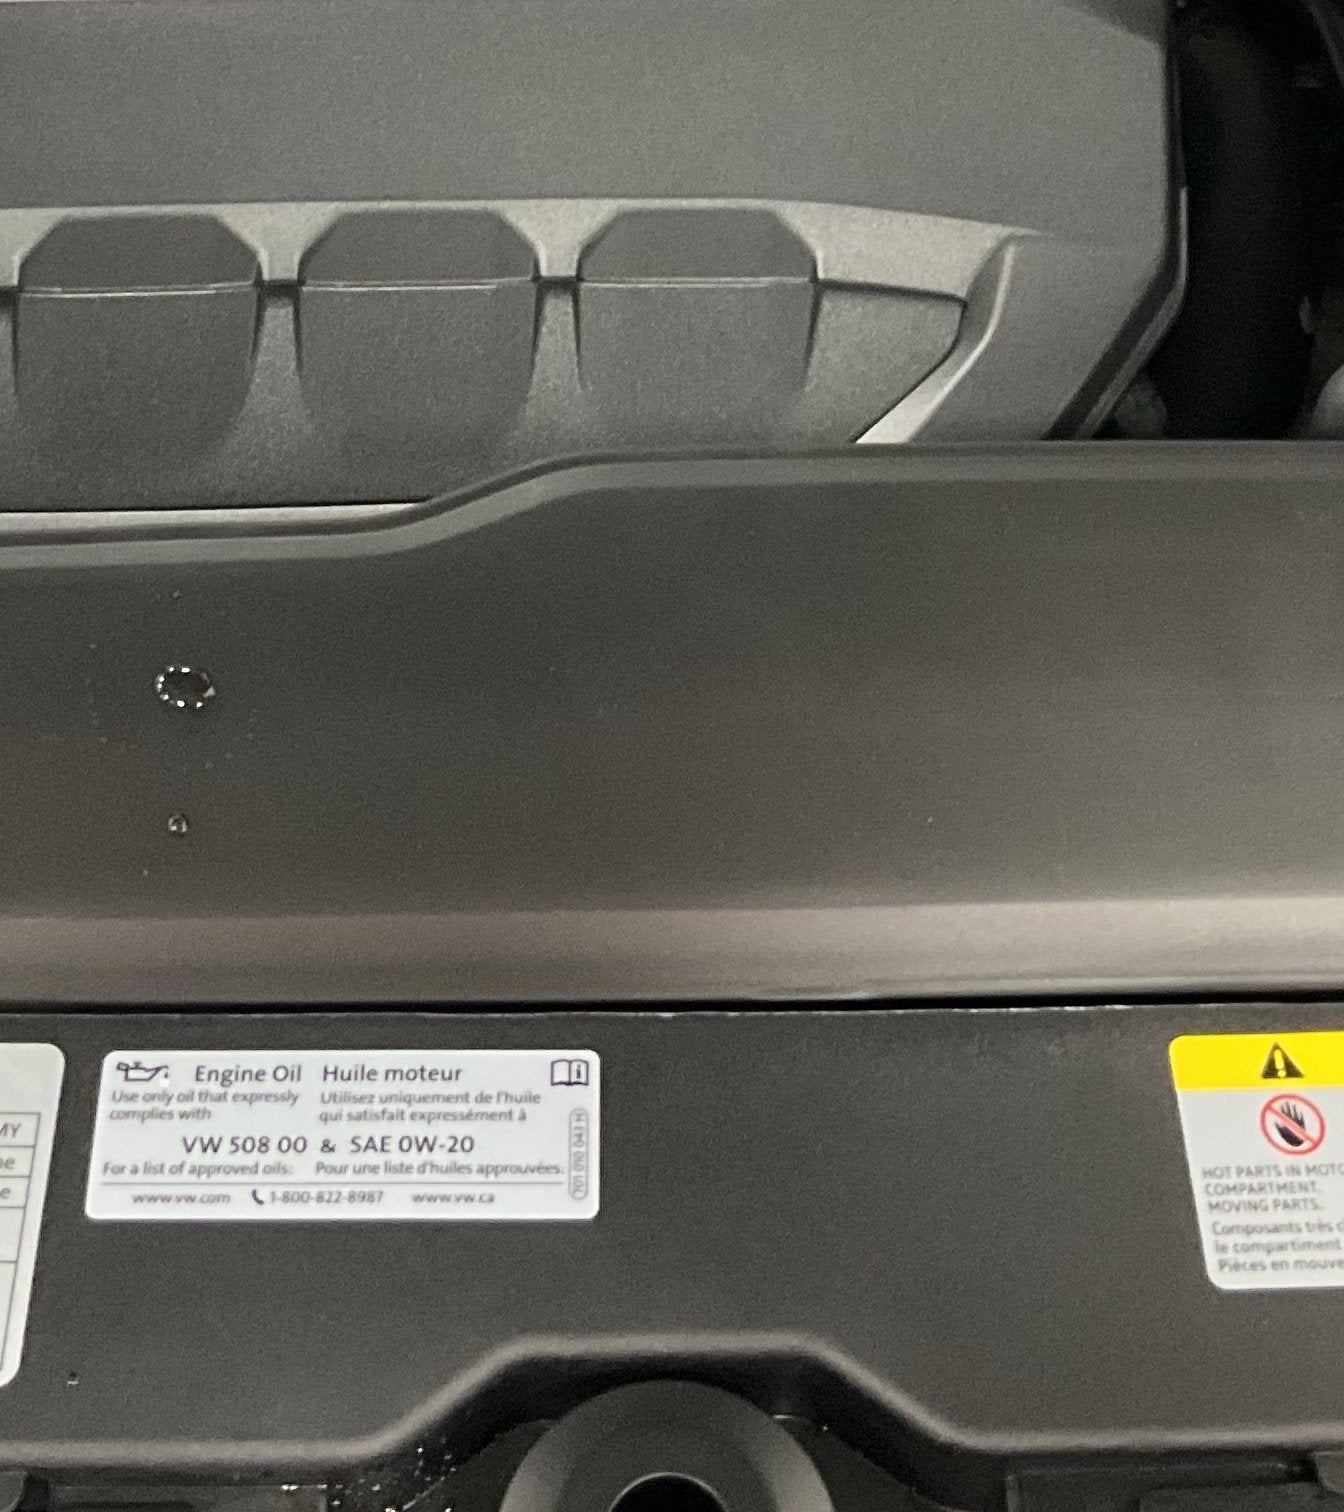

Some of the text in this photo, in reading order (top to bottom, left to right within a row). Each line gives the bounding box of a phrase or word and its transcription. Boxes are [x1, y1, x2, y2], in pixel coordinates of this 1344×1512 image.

[195, 1064, 301, 1087] Engine Oil
[322, 1064, 462, 1081] Huile moteur
[111, 1090, 299, 1106] Use only oil that expressly
[320, 1091, 541, 1108] Utilisez uniquement de l'huile
[109, 1106, 211, 1123] complies with
[318, 1108, 527, 1125] qui satisfait expressément à
[183, 1136, 475, 1153] VW 508 00 & SAE 0W-20
[103, 1162, 127, 1176] For
[130, 1165, 139, 1176] a
[143, 1161, 165, 1175] list
[169, 1161, 186, 1175] of
[188, 1161, 259, 1178] approved
[315, 1161, 349, 1174] Pour
[352, 1163, 380, 1174] une
[384, 1161, 414, 1174] liste
[417, 1160, 473, 1174] d'huiles
[1202, 1166, 1233, 1179] HOT
[1236, 1165, 1281, 1178] PARTS
[132, 1190, 495, 1204] www.vw.com 1-800-822-8987 www.vw.ca
